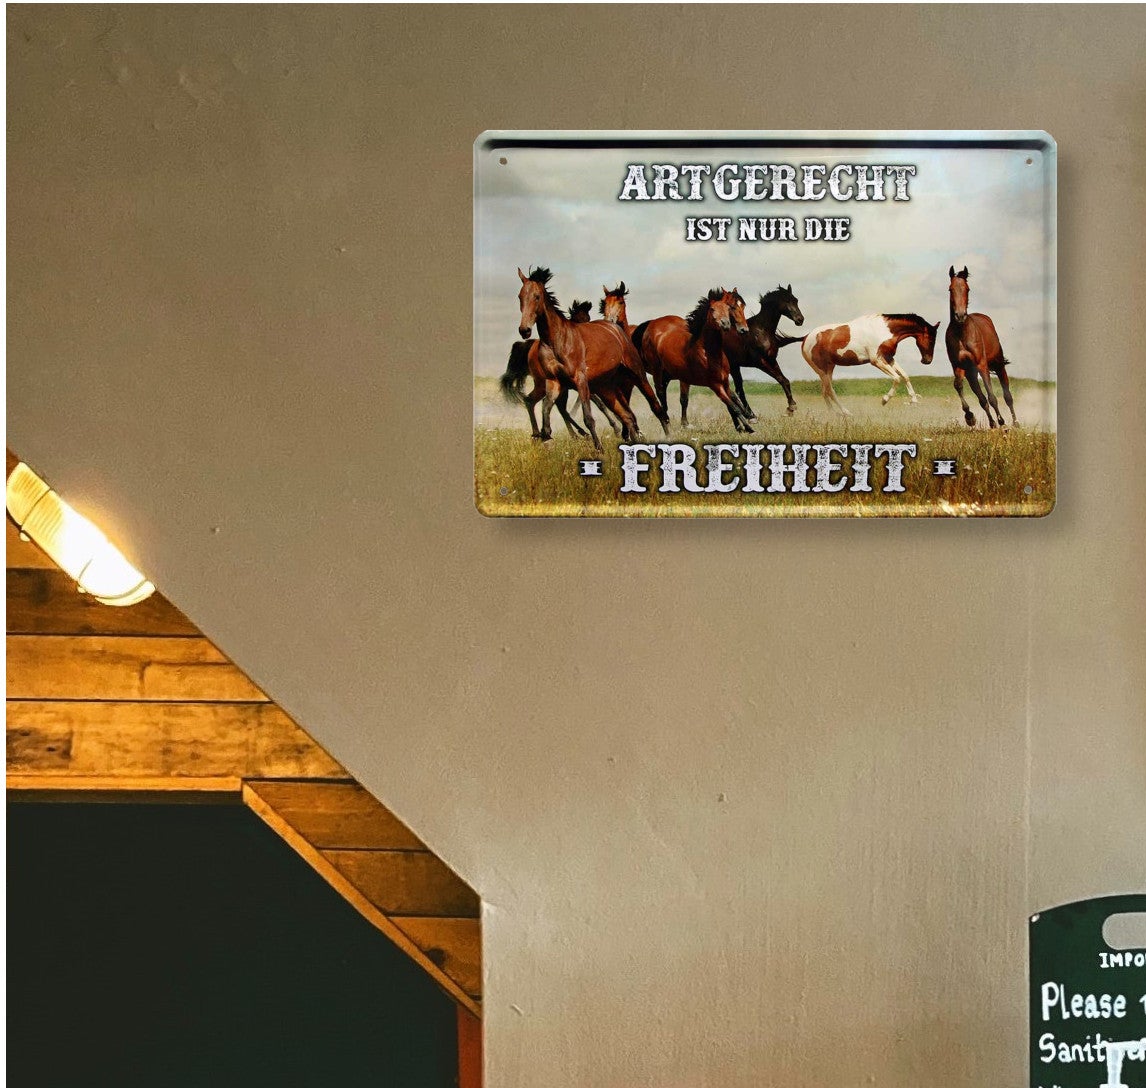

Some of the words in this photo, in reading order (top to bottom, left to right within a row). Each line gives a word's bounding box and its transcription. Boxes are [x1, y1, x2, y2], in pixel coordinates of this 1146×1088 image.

[618, 163, 916, 201] ARTGERECHT
[685, 216, 732, 241] IST
[738, 216, 798, 241] NUR
[804, 216, 850, 241] DIE
[618, 444, 917, 493] FREIHEIT
[1041, 981, 1127, 1021] Please
